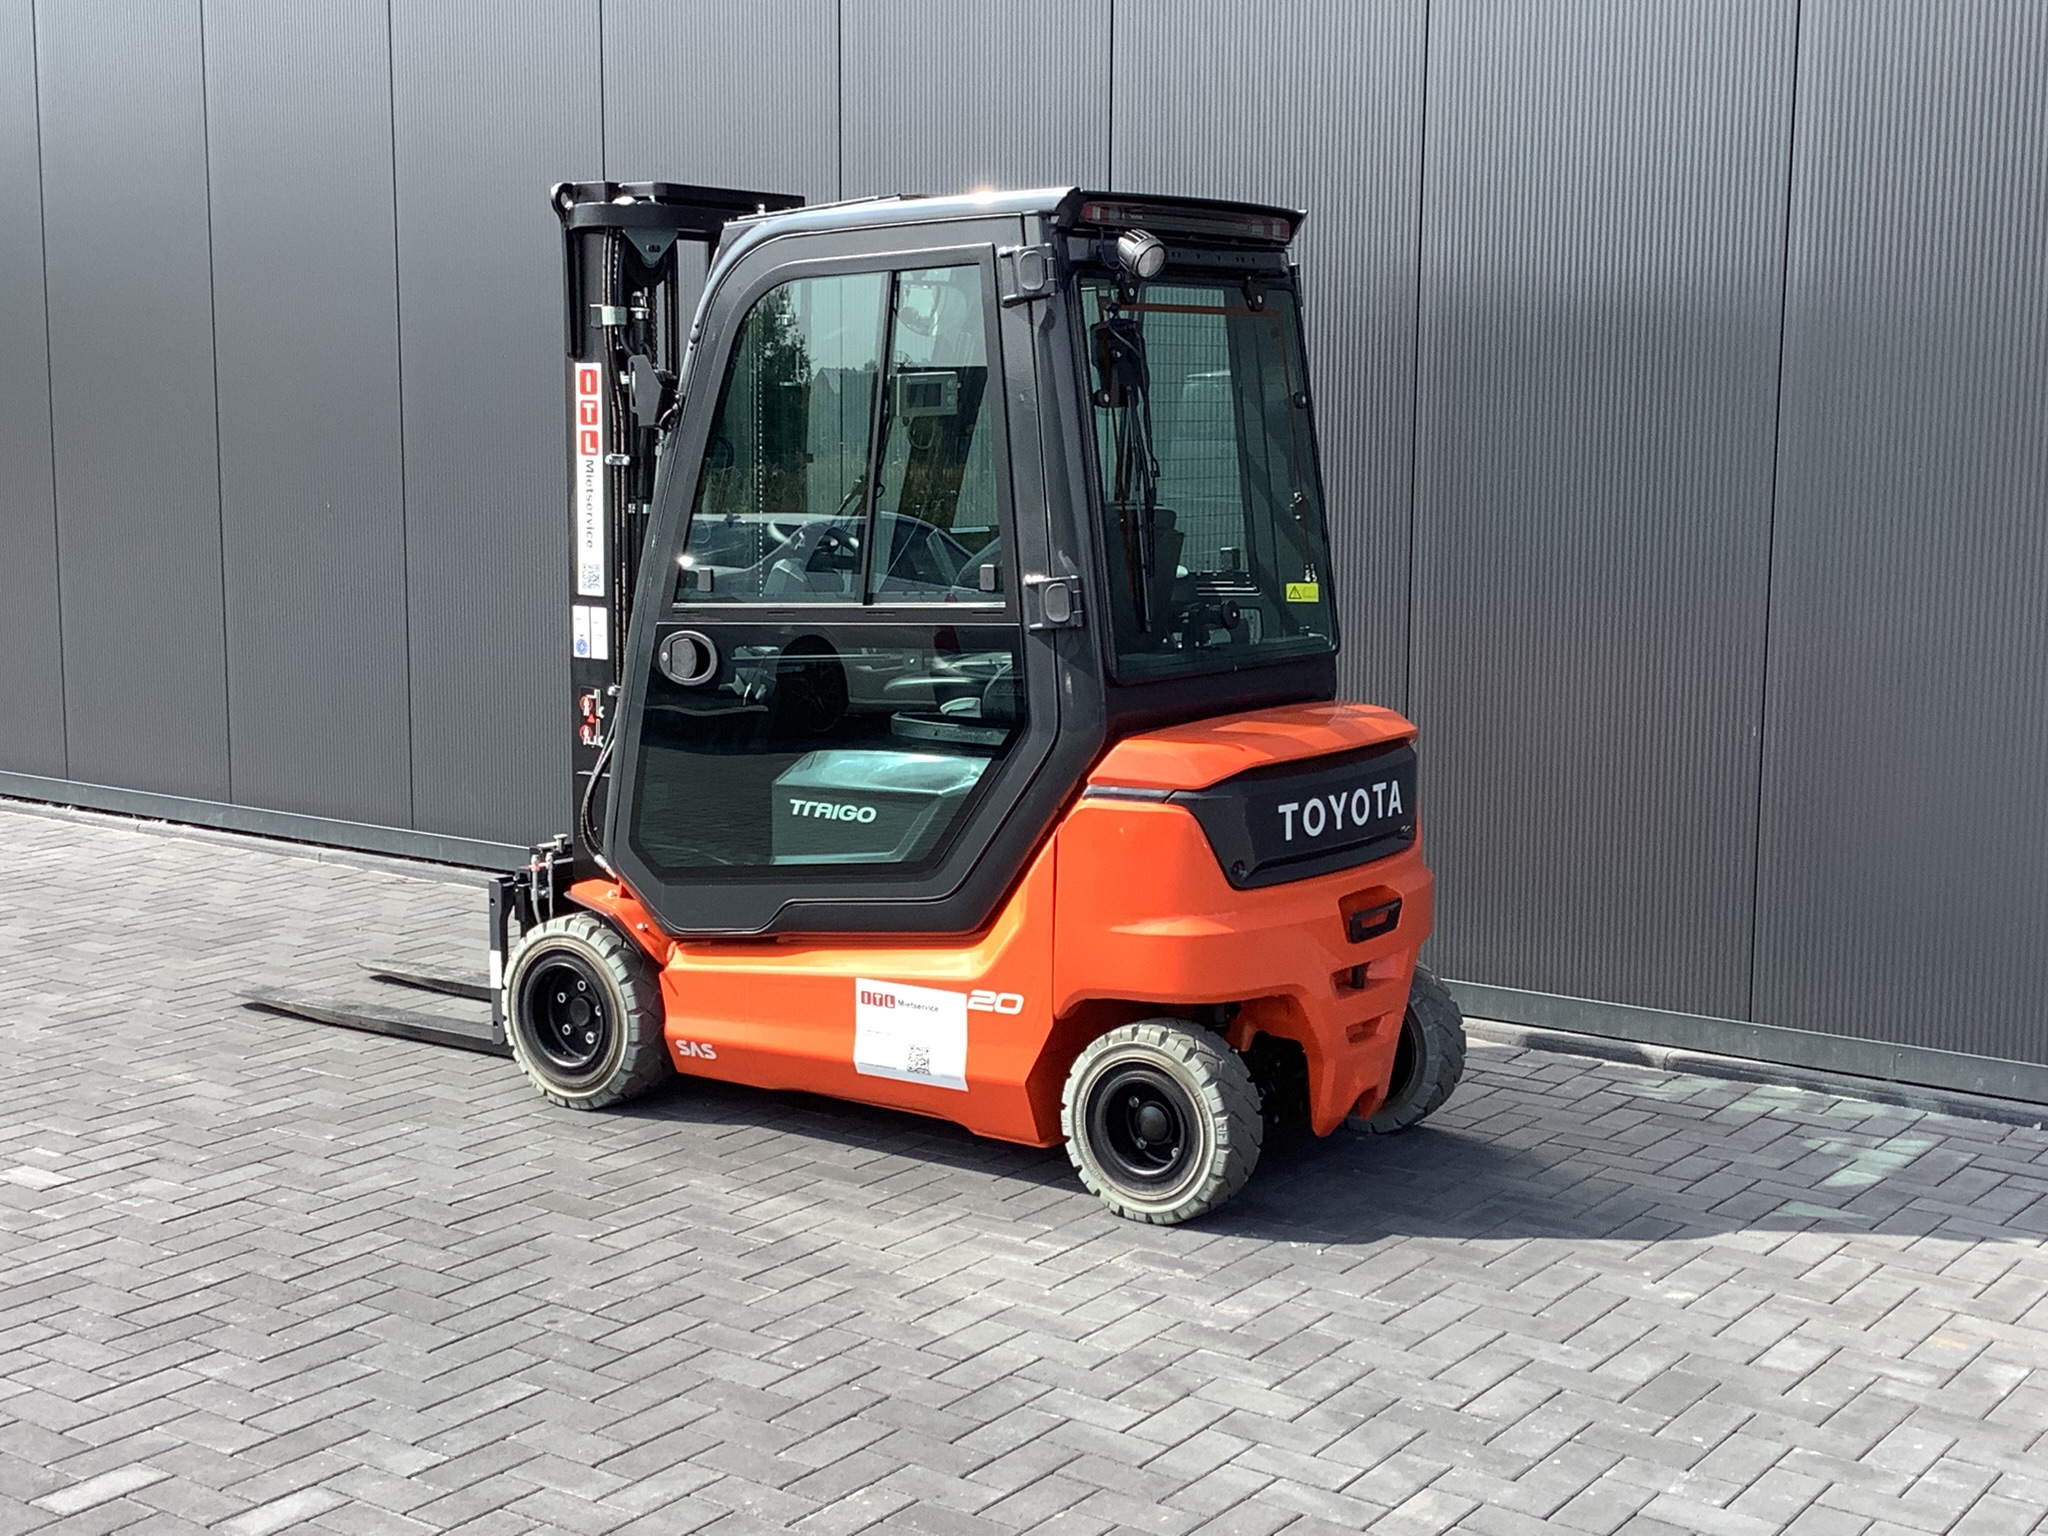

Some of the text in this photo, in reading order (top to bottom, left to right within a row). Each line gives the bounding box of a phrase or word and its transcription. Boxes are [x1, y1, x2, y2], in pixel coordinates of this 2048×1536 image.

[580, 369, 599, 548] ITL Mietservice
[1278, 780, 1403, 841] TOYOTA
[861, 990, 939, 1012] ITL Mietservice
[967, 989, 1024, 1015] 20
[675, 1039, 717, 1060] SAS
